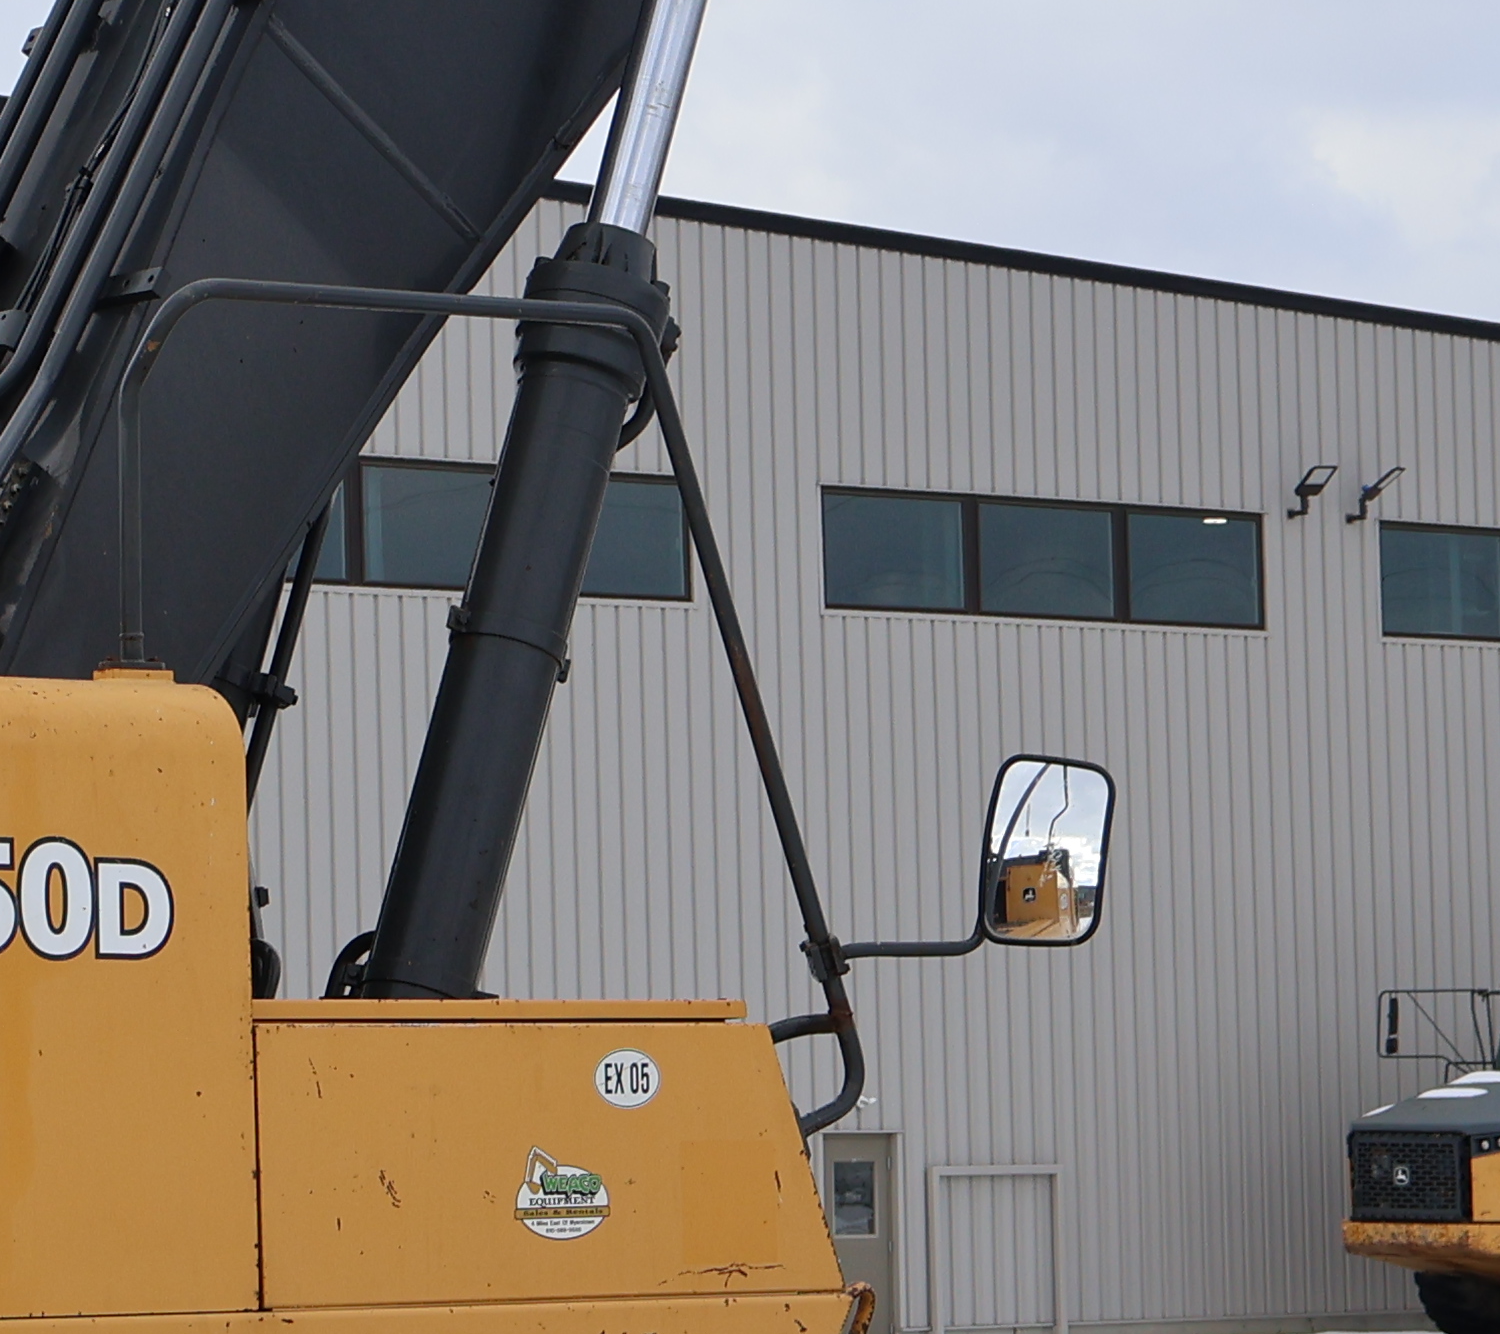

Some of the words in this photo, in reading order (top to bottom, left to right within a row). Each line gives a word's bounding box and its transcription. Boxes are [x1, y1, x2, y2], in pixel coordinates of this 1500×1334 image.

[604, 1063, 625, 1094] EX
[630, 1062, 650, 1094] 05
[540, 1170, 602, 1197] WEACO
[528, 1197, 596, 1208] EQUIPMENT
